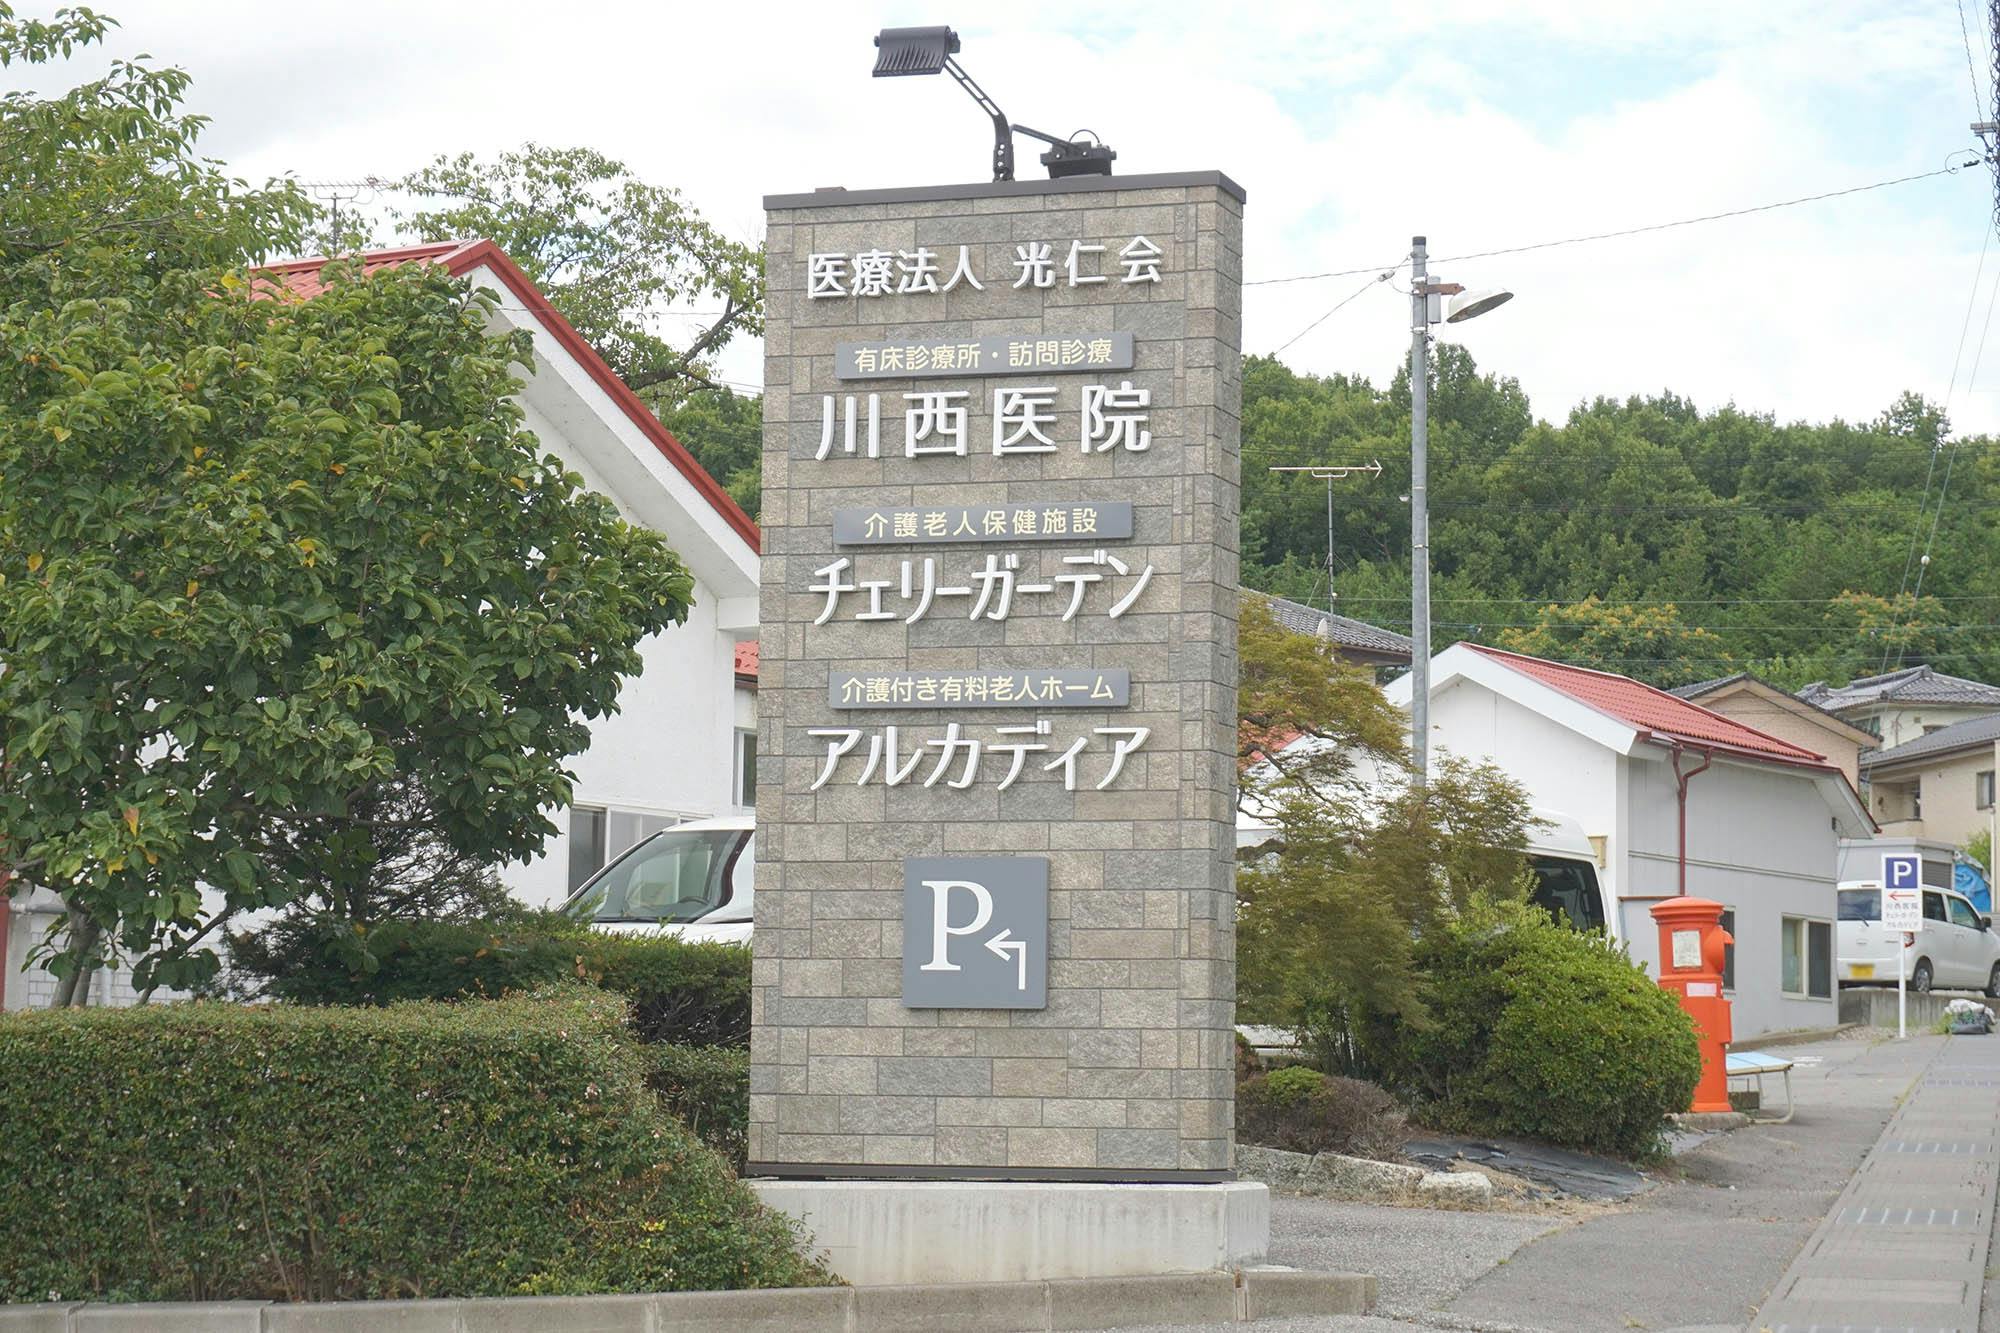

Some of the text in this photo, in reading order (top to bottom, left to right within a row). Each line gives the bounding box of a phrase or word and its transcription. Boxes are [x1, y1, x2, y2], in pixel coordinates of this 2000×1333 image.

[807, 235, 1163, 299] 医療法人 光仁会
[853, 338, 1113, 373] 有床診療所・訪問診療
[814, 381, 1153, 461] 川西医院
[863, 507, 1098, 539] 介護老人保健施設
[808, 549, 1154, 625] チェリーガーデン
[840, 675, 1114, 703] 介護付き有料老人ホーム
[807, 719, 1151, 791] アルカディア
[1893, 860, 1912, 886] P
[919, 879, 994, 972] P
